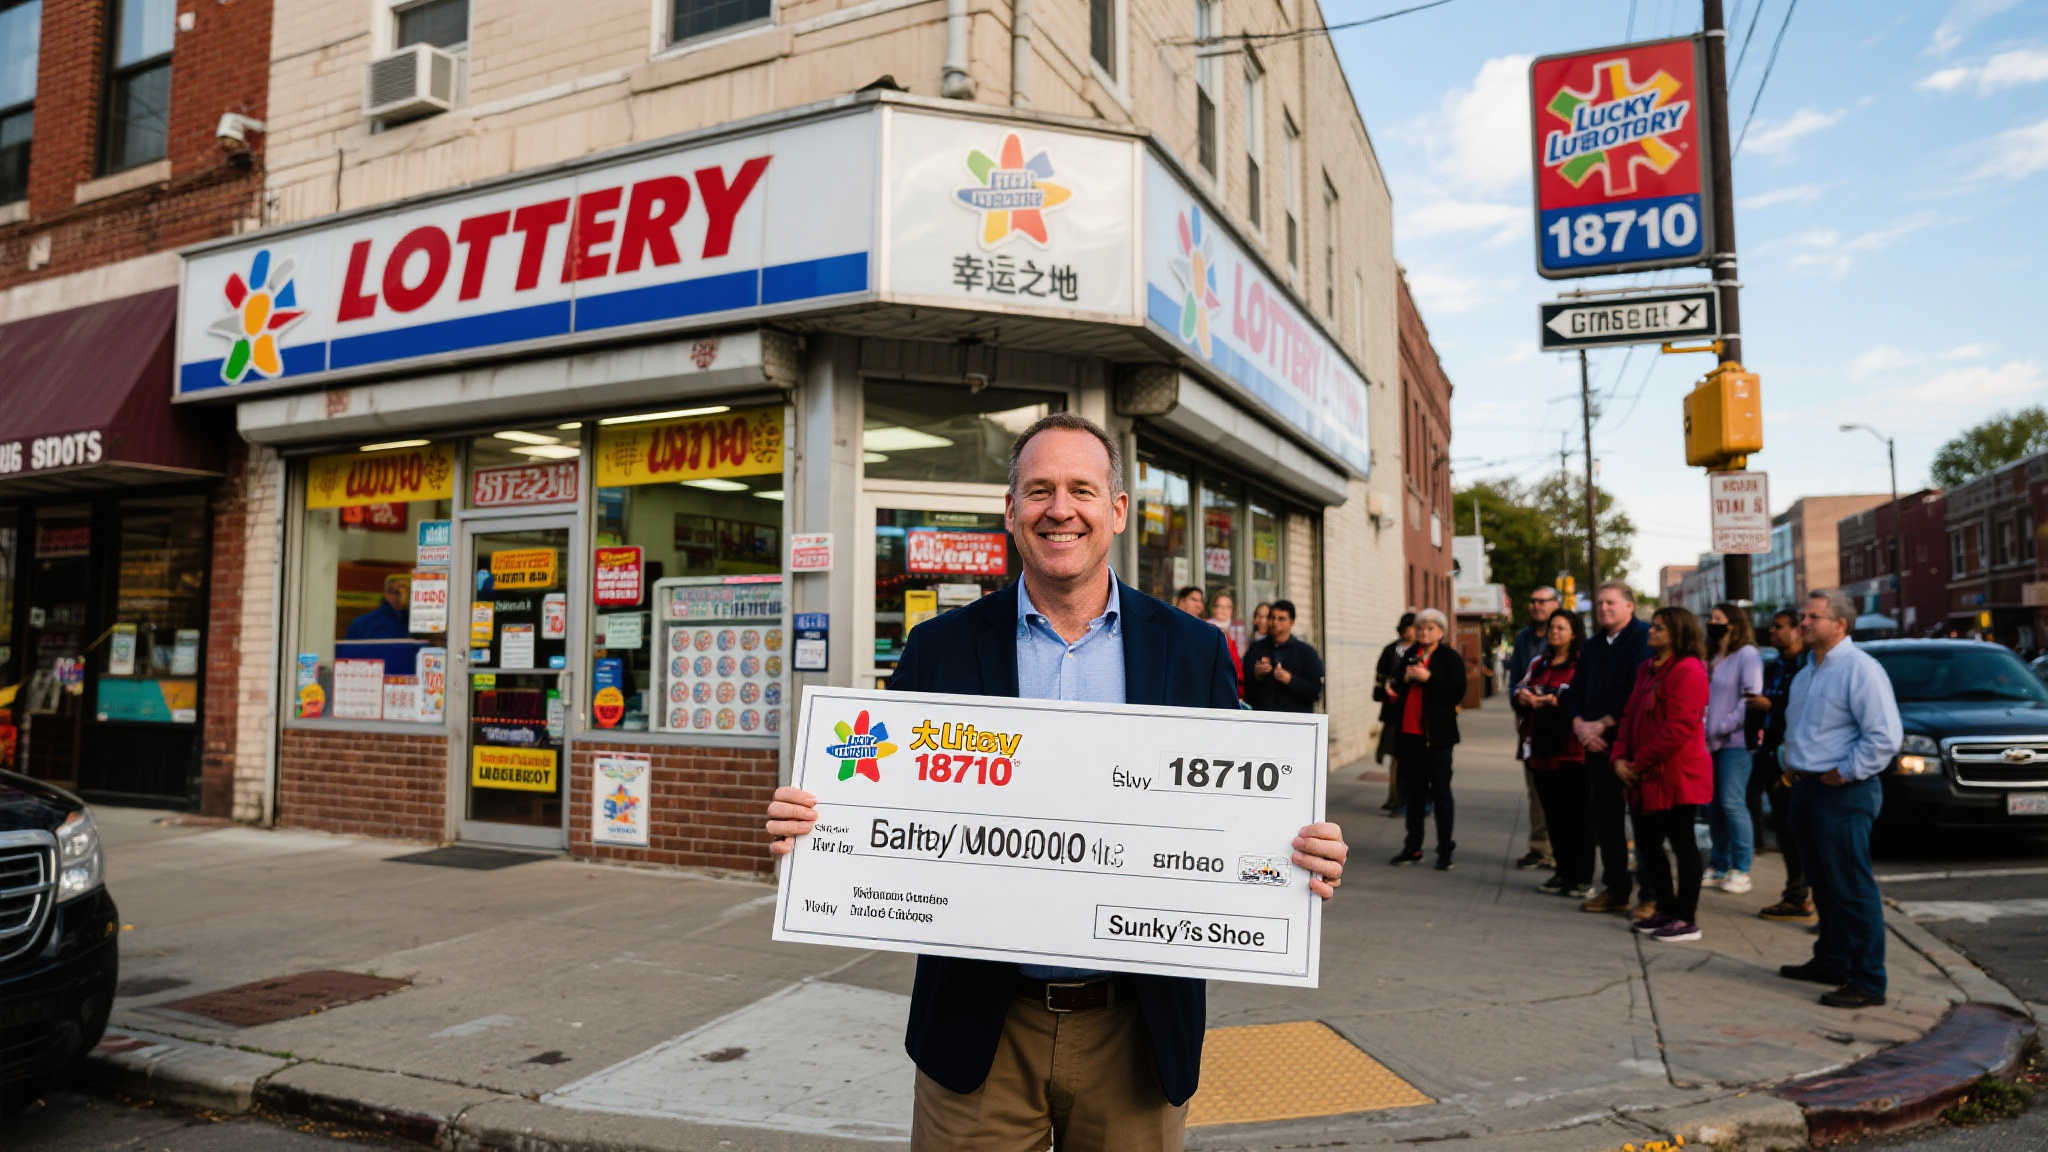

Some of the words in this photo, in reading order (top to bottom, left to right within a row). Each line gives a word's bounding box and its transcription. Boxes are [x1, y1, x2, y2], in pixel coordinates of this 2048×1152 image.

[1575, 92, 1657, 132] LUCKY
[337, 155, 774, 323] LOTTERY
[1549, 203, 1697, 258] 18710
[953, 254, 1079, 301] 幸运之地
[915, 753, 1012, 786] 18710
[1208, 922, 1265, 947] Shoe
